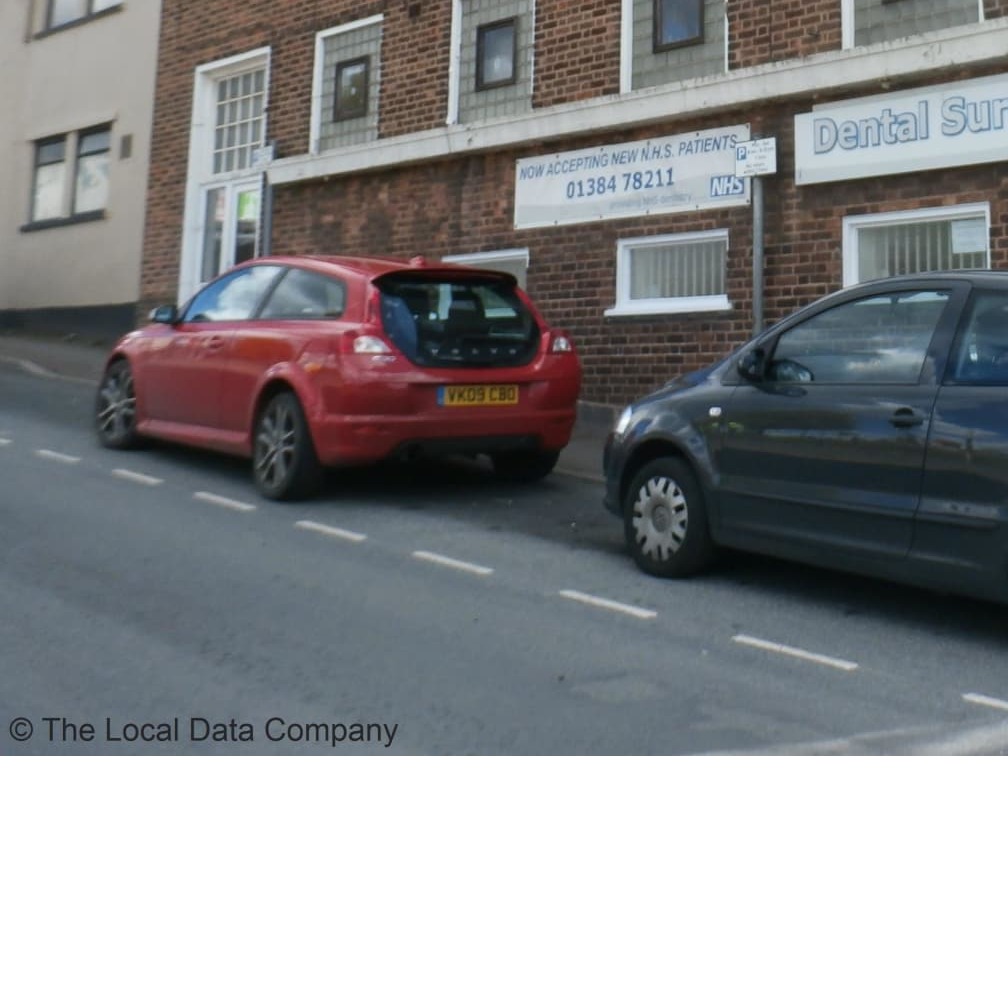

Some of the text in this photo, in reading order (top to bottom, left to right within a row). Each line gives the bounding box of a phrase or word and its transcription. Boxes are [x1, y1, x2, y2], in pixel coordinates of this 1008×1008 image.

[813, 99, 929, 155] Dental
[519, 134, 738, 181] NOW ACCEPTING NEW N.H.S. PATIENTS
[566, 167, 675, 199] 01384 78211
[711, 176, 744, 197] NHS
